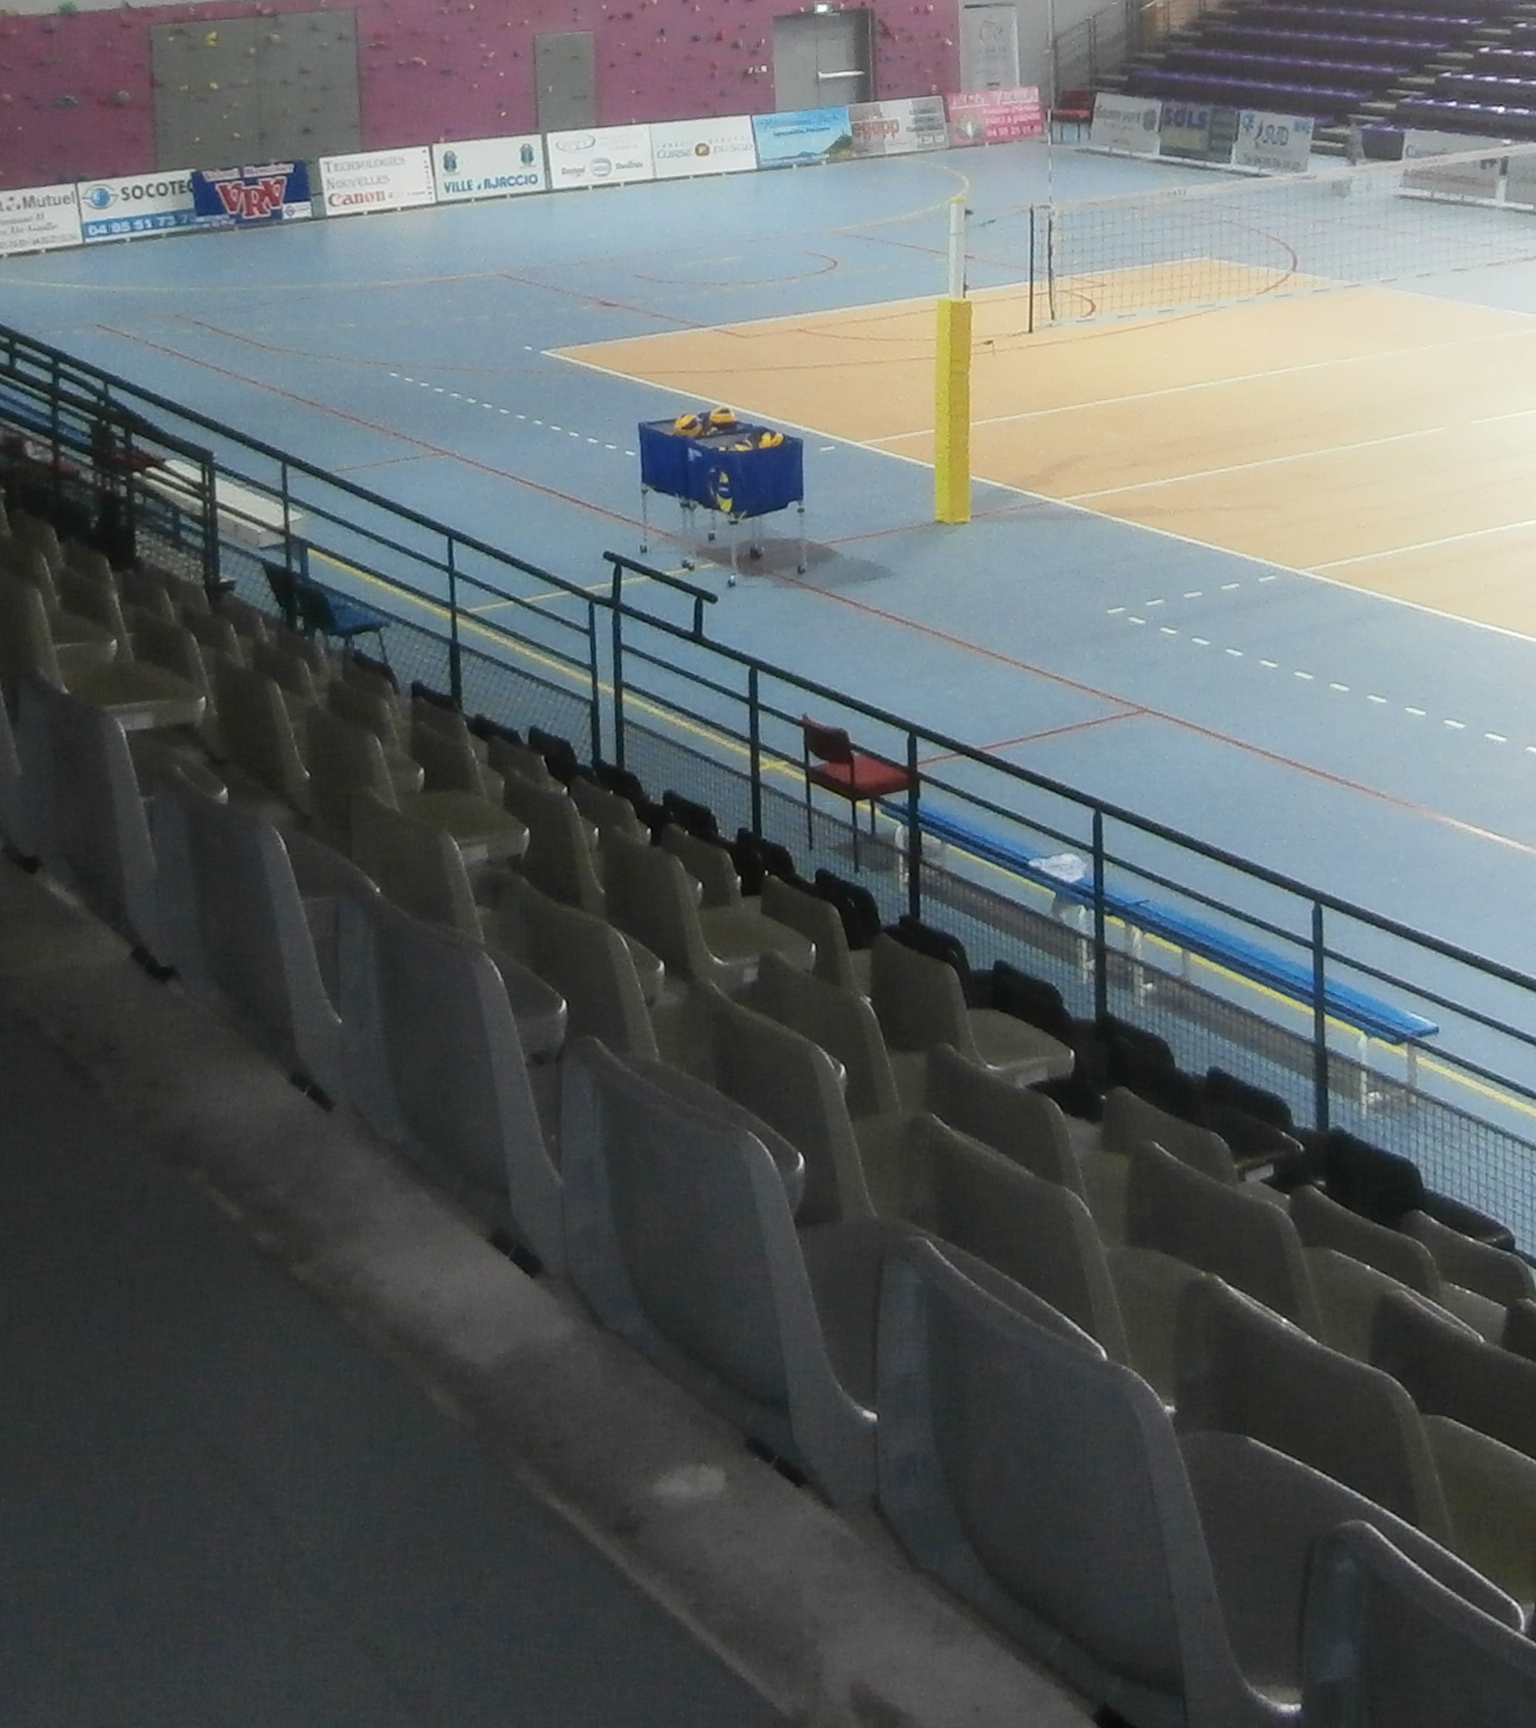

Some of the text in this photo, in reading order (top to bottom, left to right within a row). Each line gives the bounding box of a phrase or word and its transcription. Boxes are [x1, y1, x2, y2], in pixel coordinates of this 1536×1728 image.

[443, 179, 473, 193] VILLE
[22, 190, 75, 209] Mutuel
[328, 190, 385, 207] Canon
